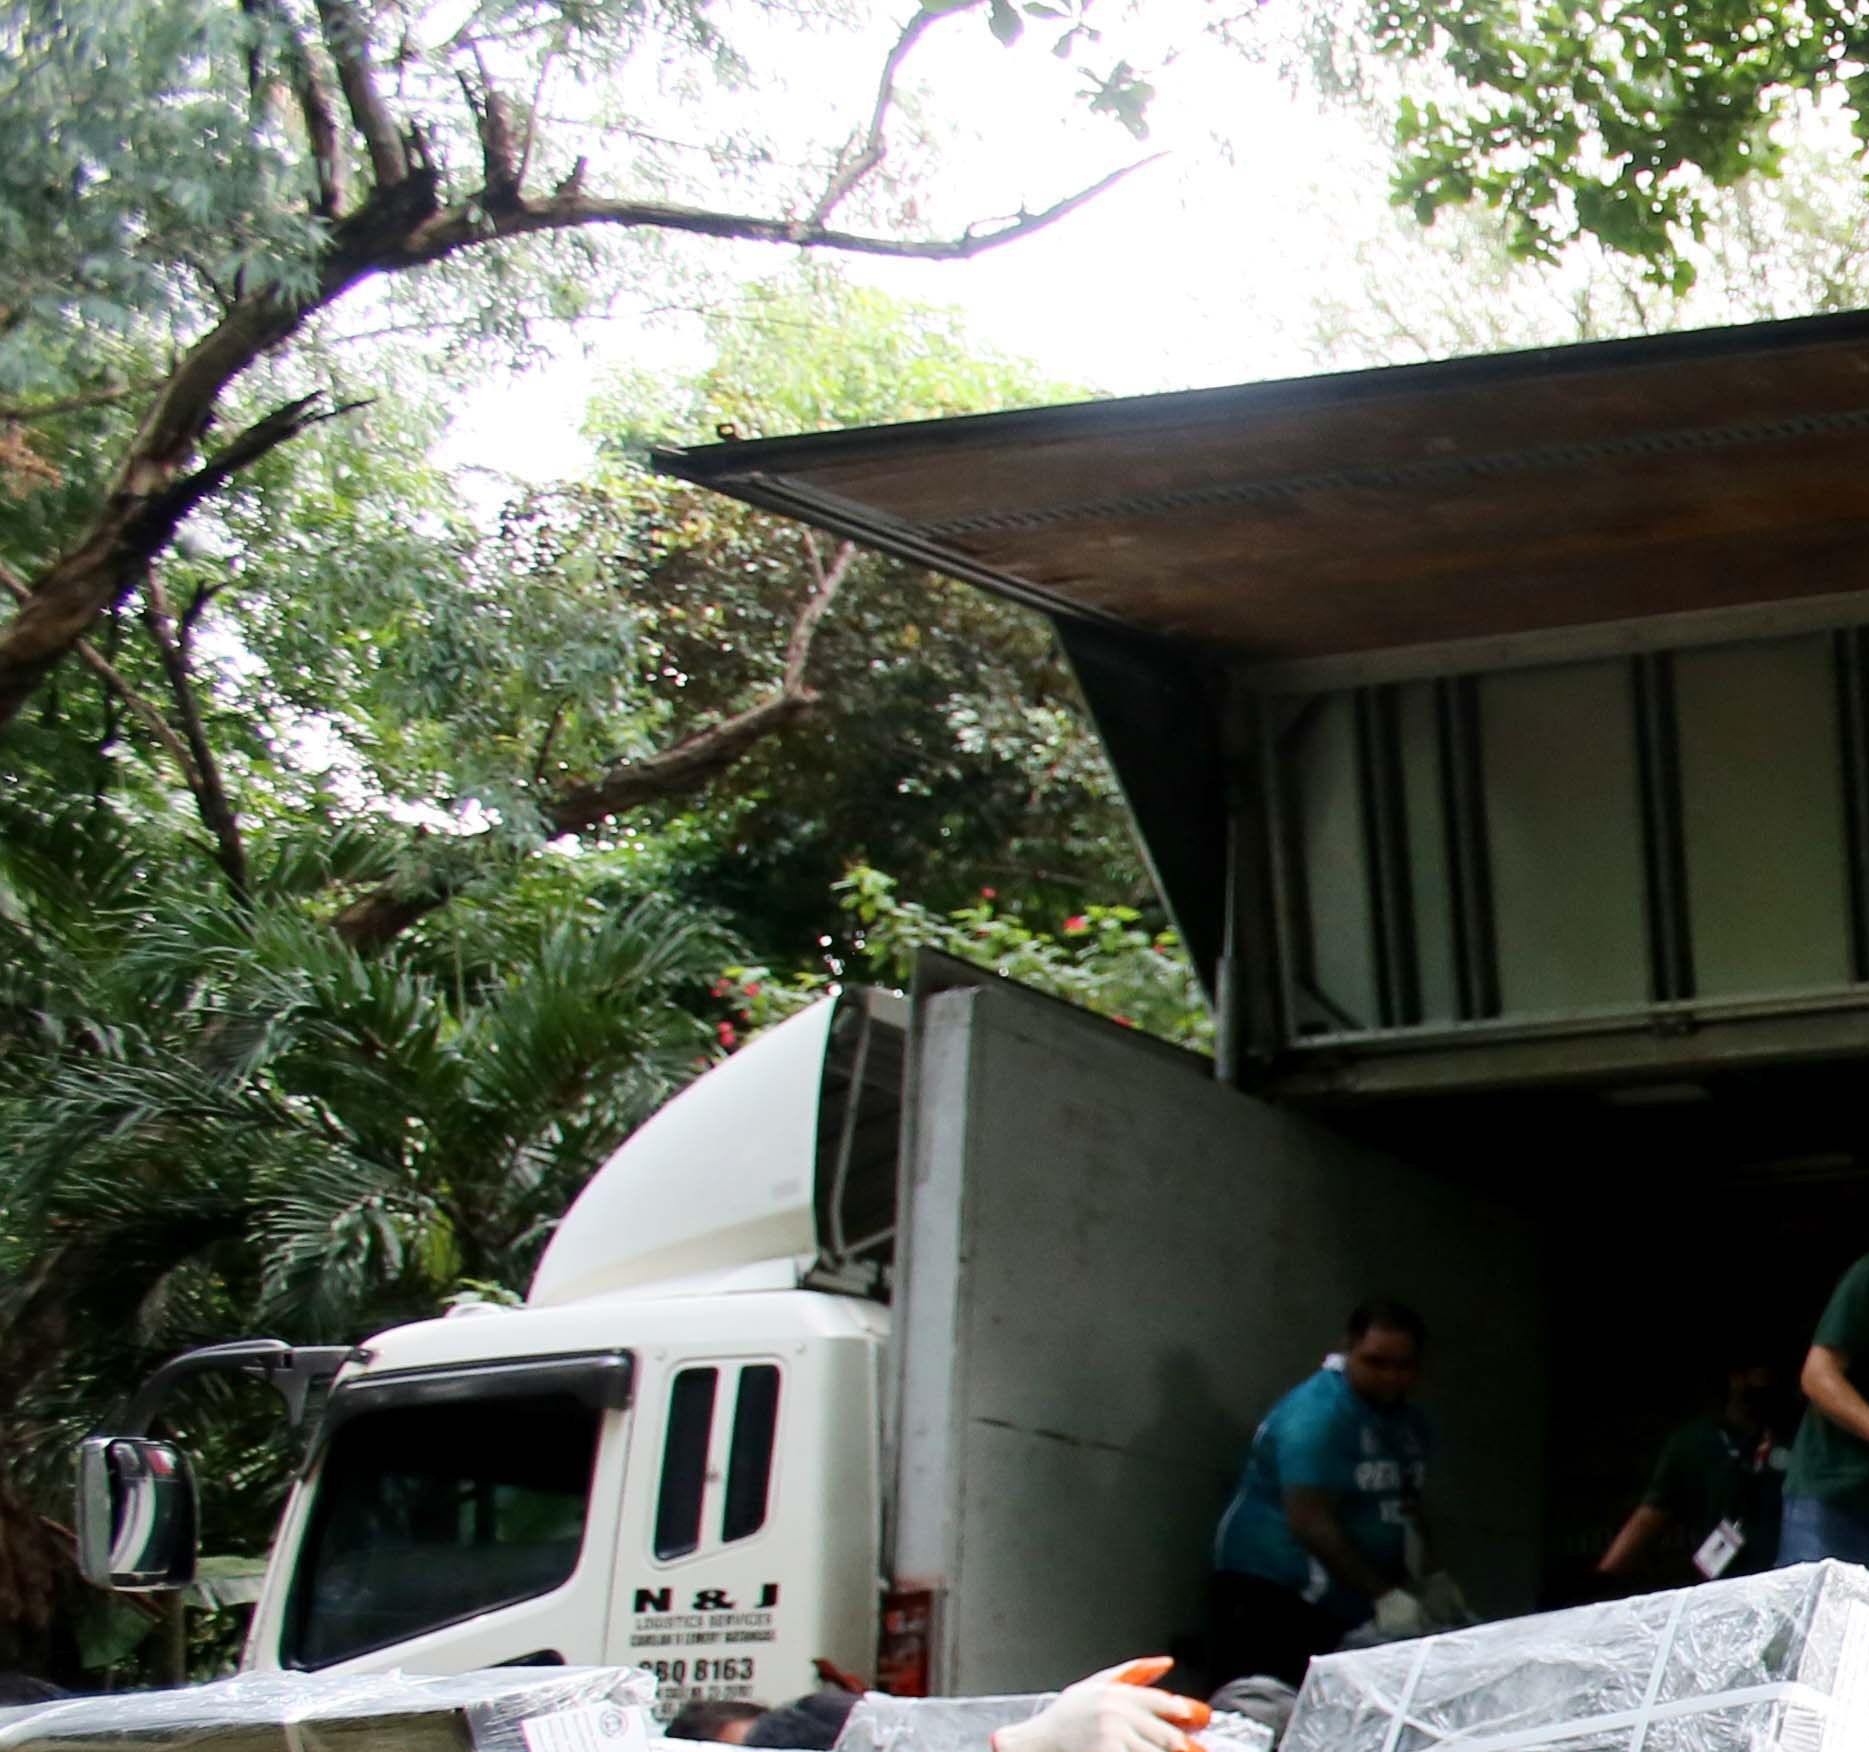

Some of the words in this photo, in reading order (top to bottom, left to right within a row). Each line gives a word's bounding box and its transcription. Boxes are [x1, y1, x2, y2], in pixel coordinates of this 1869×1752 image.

[632, 1587, 673, 1613] N
[690, 1589, 736, 1611] &
[754, 1583, 782, 1609] J
[635, 1616, 704, 1631] LOGISTICS
[709, 1612, 773, 1628] SERVICES
[693, 1657, 755, 1683] 8163
